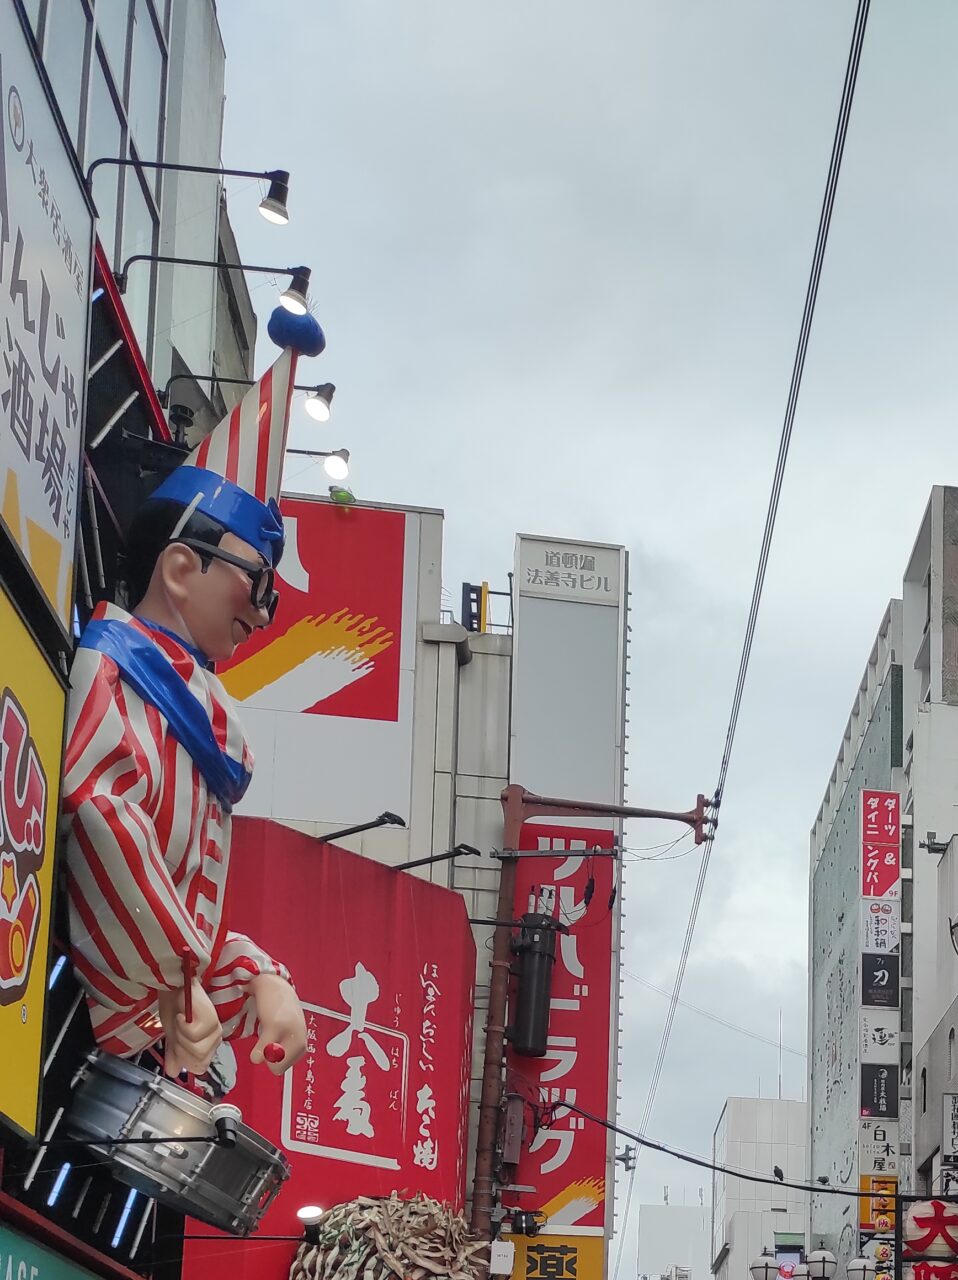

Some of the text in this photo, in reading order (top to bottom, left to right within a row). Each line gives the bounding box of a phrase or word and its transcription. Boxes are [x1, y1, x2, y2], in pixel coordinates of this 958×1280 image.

[527, 568, 611, 592] 法善寺ビル
[884, 798, 897, 836] ダーツ
[866, 797, 880, 896] ダイニングバー
[884, 852, 896, 866] &
[873, 969, 889, 986] 刀
[861, 1122, 872, 1130] 4F
[872, 1125, 896, 1171] 白木屋
